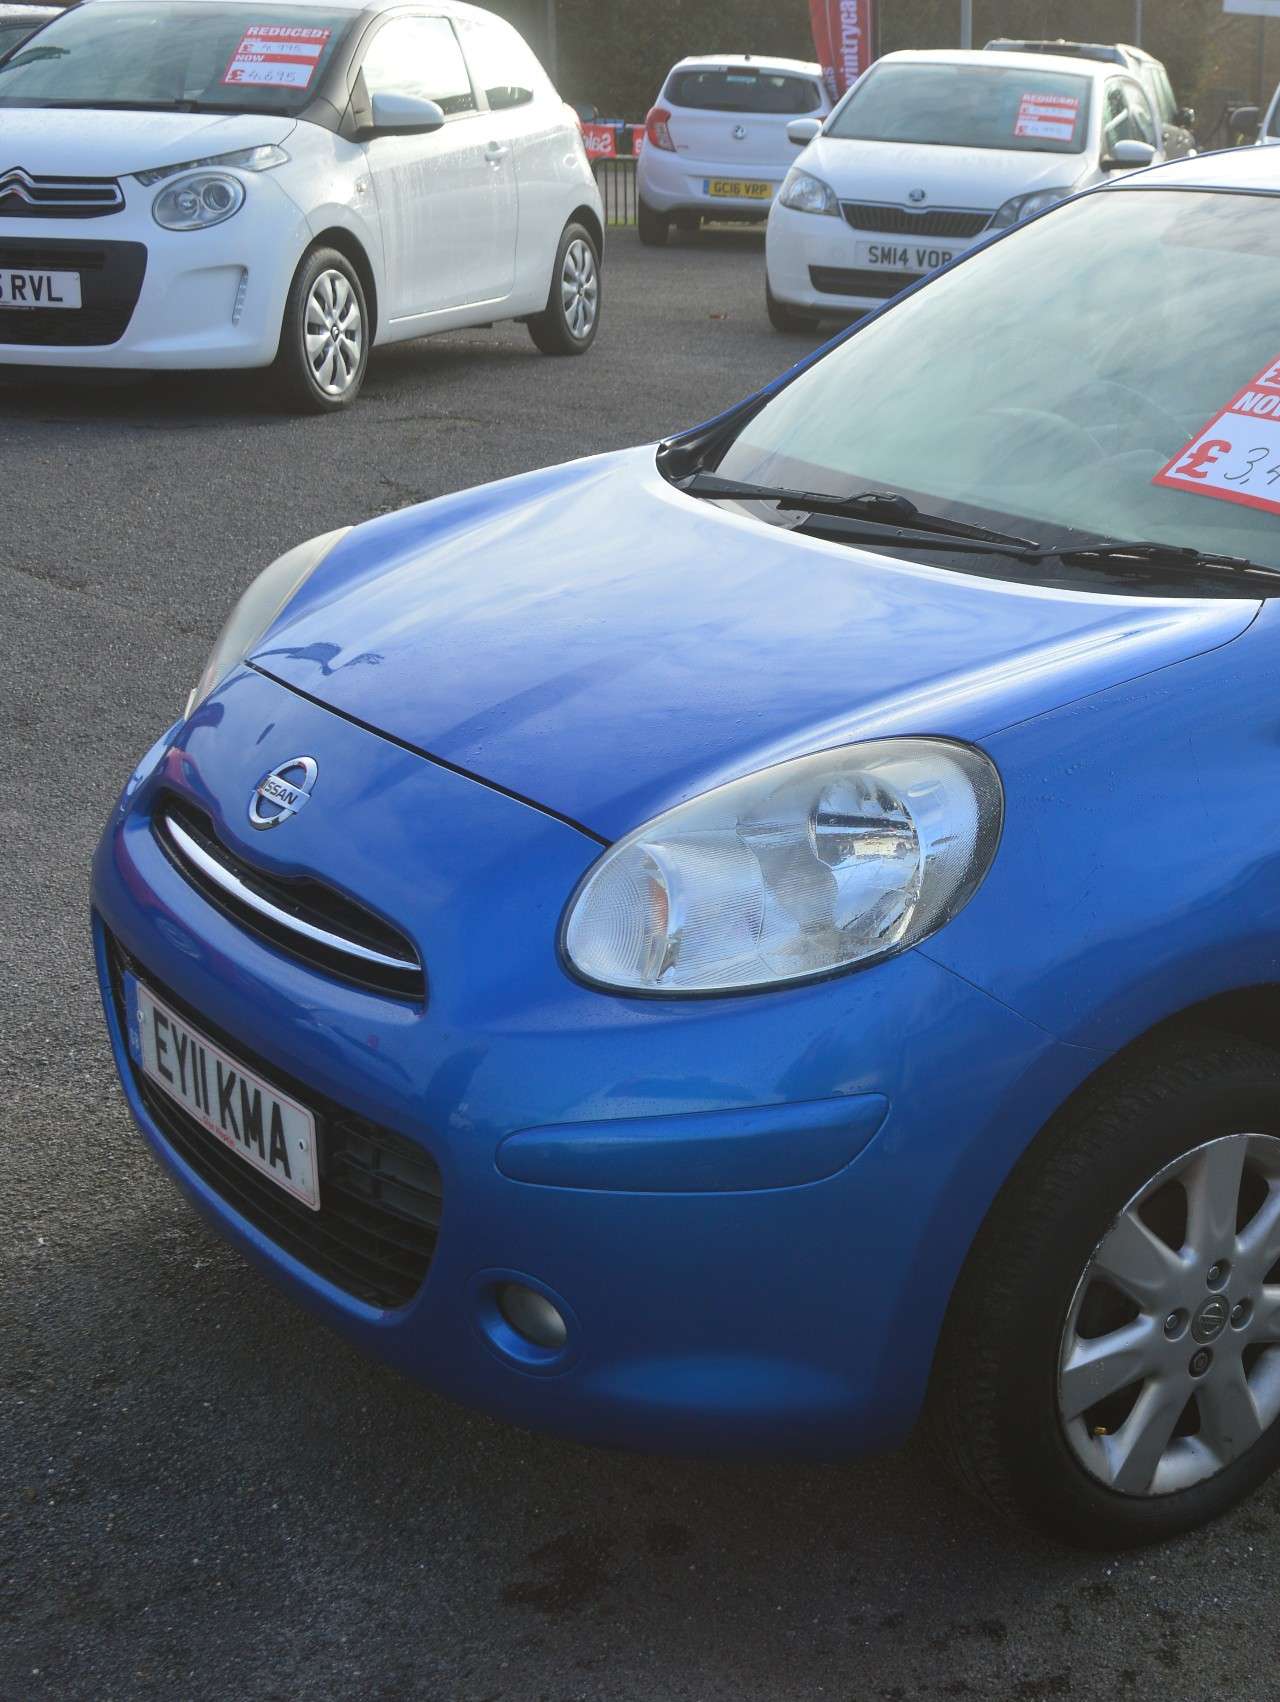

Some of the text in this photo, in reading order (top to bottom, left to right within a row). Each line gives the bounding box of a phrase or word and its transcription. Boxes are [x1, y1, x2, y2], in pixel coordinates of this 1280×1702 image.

[246, 26, 331, 39] REDUCED!
[868, 246, 910, 267] SM14
[11, 273, 64, 302] RVL
[257, 777, 299, 805] ISSAN
[153, 1006, 292, 1181] EY11 KMA
